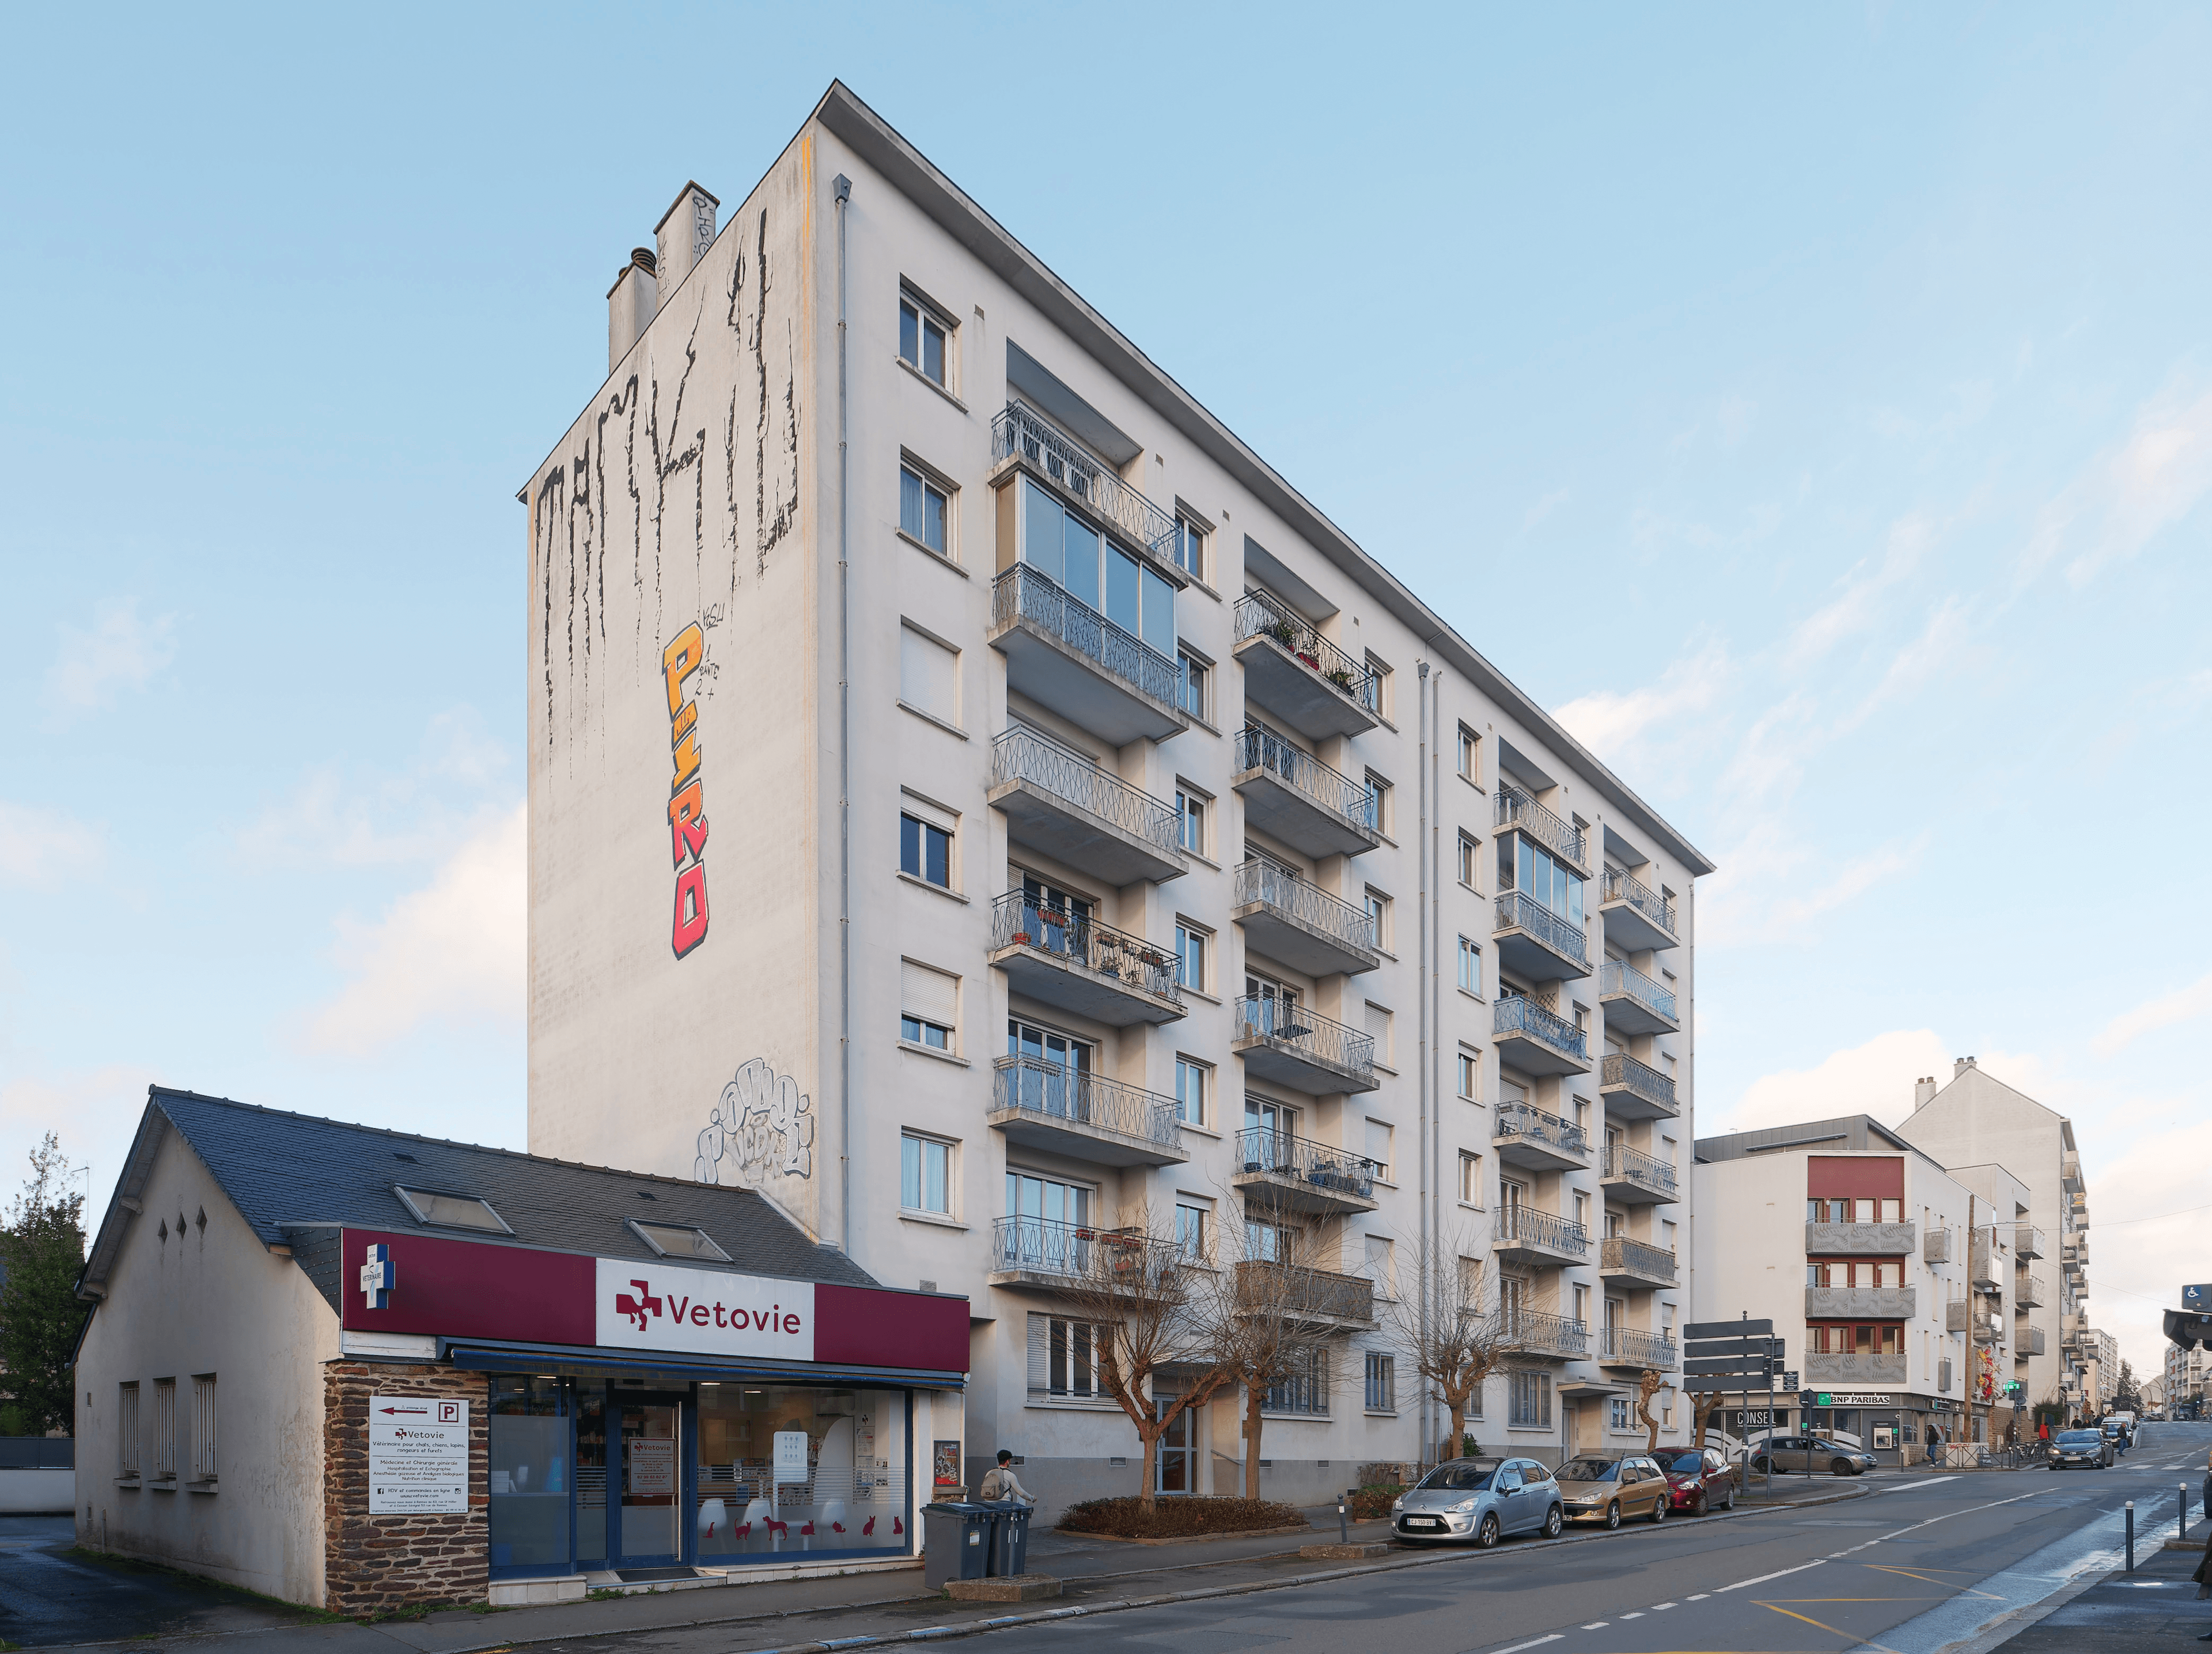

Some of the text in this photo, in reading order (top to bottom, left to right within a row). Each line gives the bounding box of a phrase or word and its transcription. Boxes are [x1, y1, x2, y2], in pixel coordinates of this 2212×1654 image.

[667, 1295, 801, 1334] Vetovie
[444, 1406, 454, 1419] P
[1737, 1412, 1776, 1424] CNSEL
